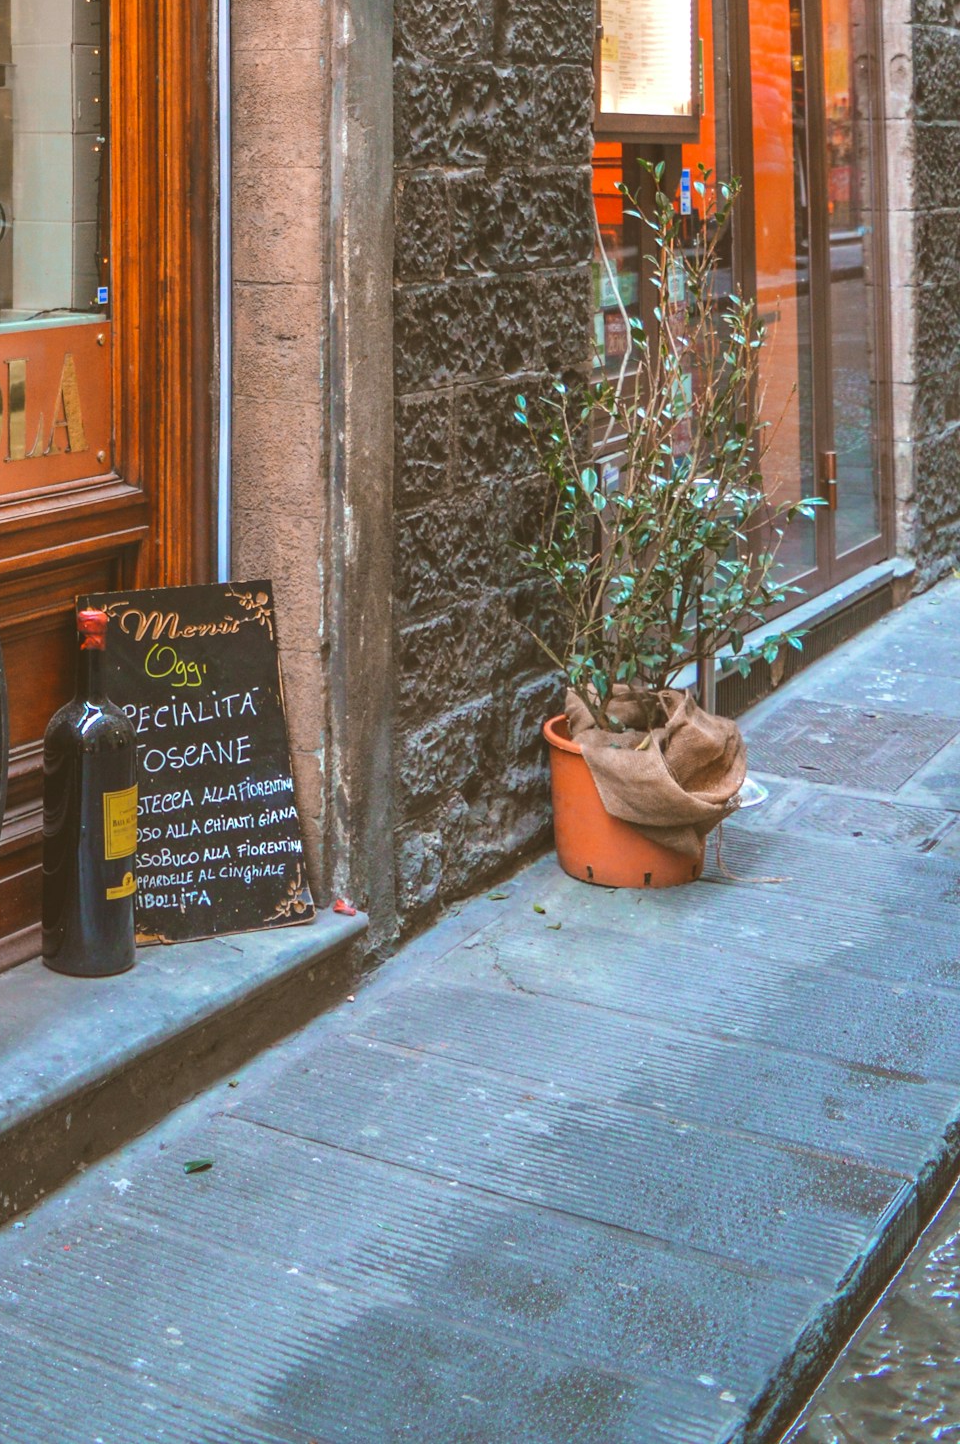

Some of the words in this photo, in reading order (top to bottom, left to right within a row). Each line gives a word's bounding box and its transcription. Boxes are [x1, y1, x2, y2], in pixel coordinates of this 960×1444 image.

[144, 643, 207, 687] Oggi
[136, 735, 252, 772] OSCANE
[137, 789, 194, 816] STECCA
[201, 784, 237, 805] ALLA
[165, 818, 201, 839] ALLA
[203, 845, 231, 862] ALLA
[136, 872, 194, 889] PPARDELLE
[198, 869, 216, 883] AL
[136, 888, 212, 910] IBOLLITA
